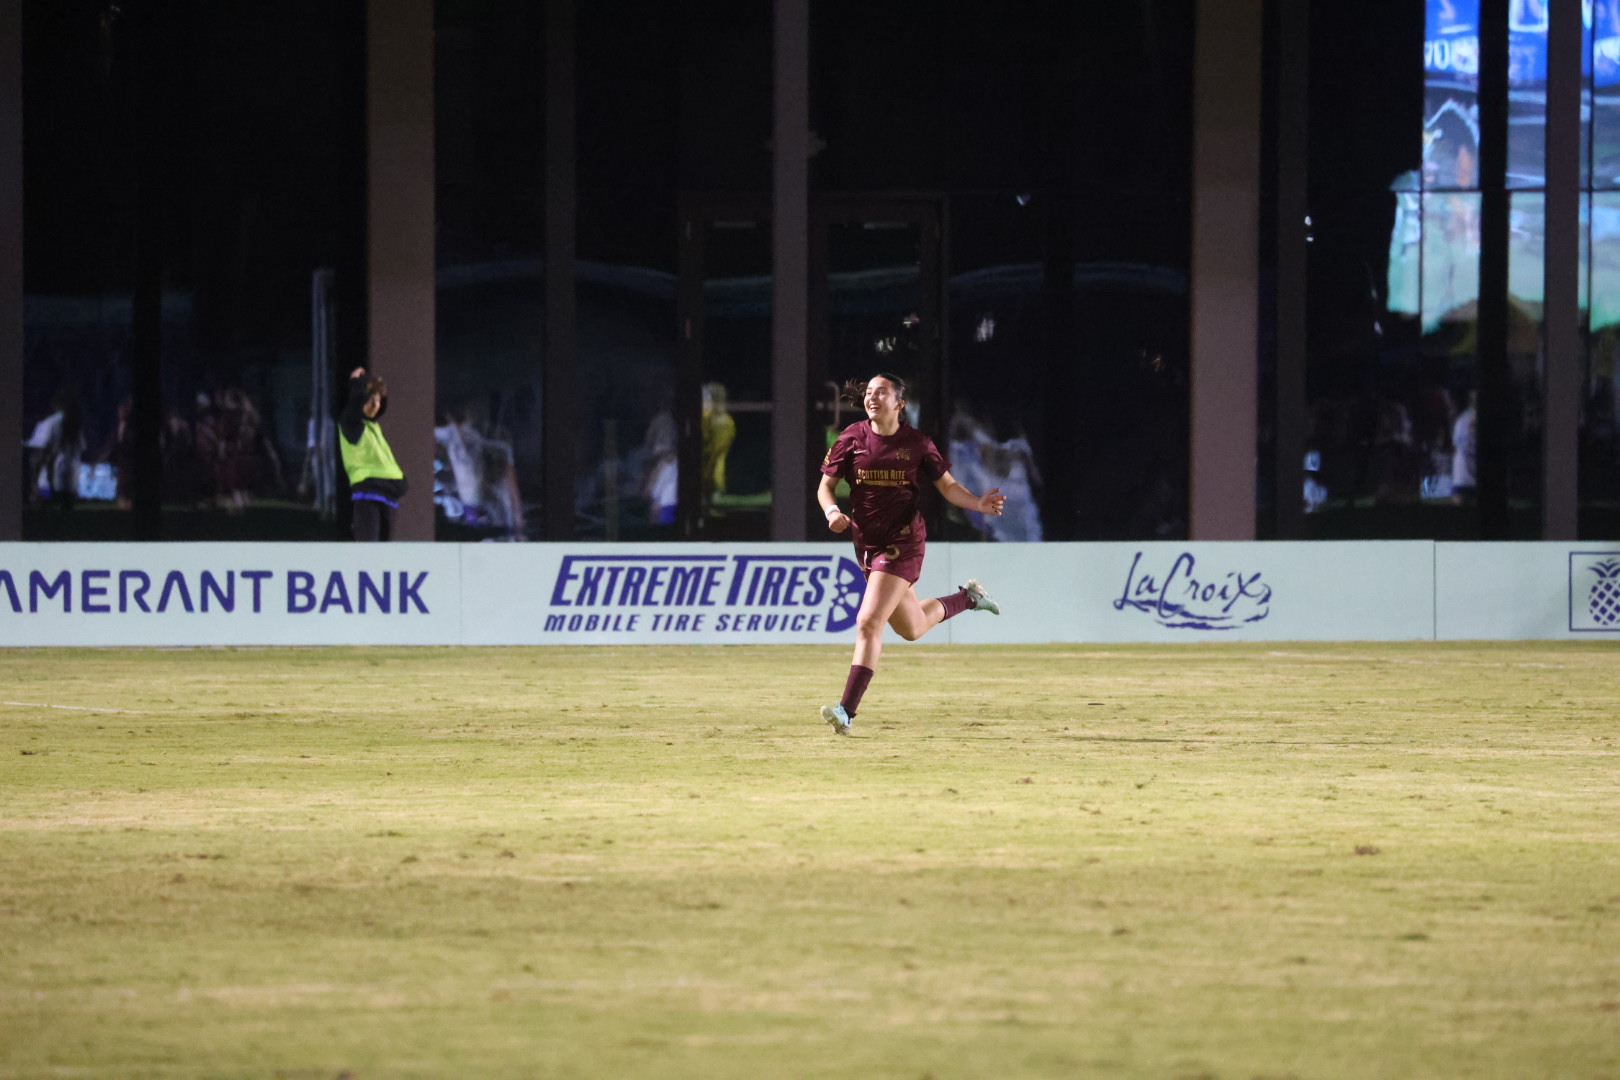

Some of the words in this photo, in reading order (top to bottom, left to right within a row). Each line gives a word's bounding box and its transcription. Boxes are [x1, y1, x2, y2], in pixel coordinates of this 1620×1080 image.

[857, 469, 888, 479] SCOTTISH
[891, 470, 905, 479] RITE
[287, 570, 430, 614] BANK
[549, 555, 727, 607] EXTREME
[725, 555, 833, 607] TIRES
[543, 613, 640, 632] MOBILE
[651, 613, 705, 632] TIRE
[715, 613, 822, 632] SERVICE
